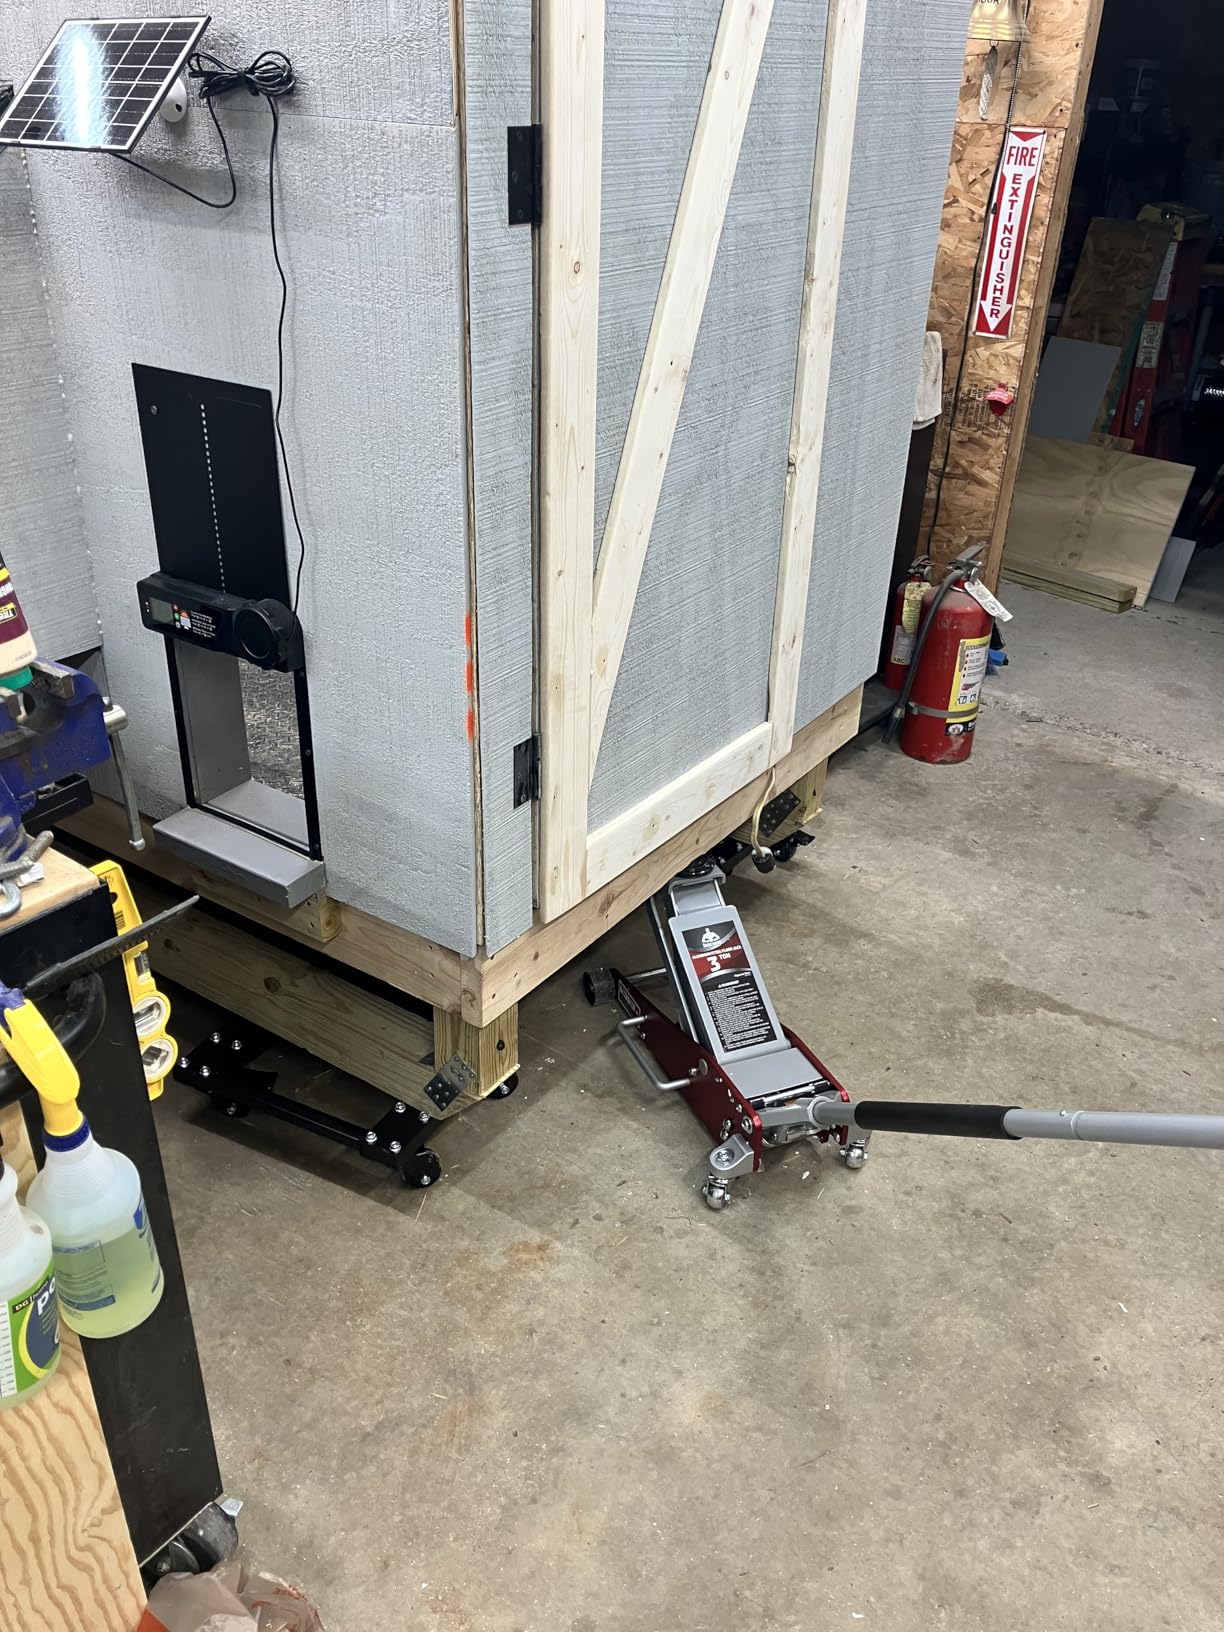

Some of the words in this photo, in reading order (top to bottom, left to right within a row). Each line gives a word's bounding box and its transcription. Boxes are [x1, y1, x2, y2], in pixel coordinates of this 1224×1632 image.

[1006, 145, 1038, 168] FIRE
[989, 173, 1023, 319] EXTINGUISHER
[706, 955, 721, 973] 3
[719, 952, 731, 960] TON
[15, 1300, 29, 1311] DG
